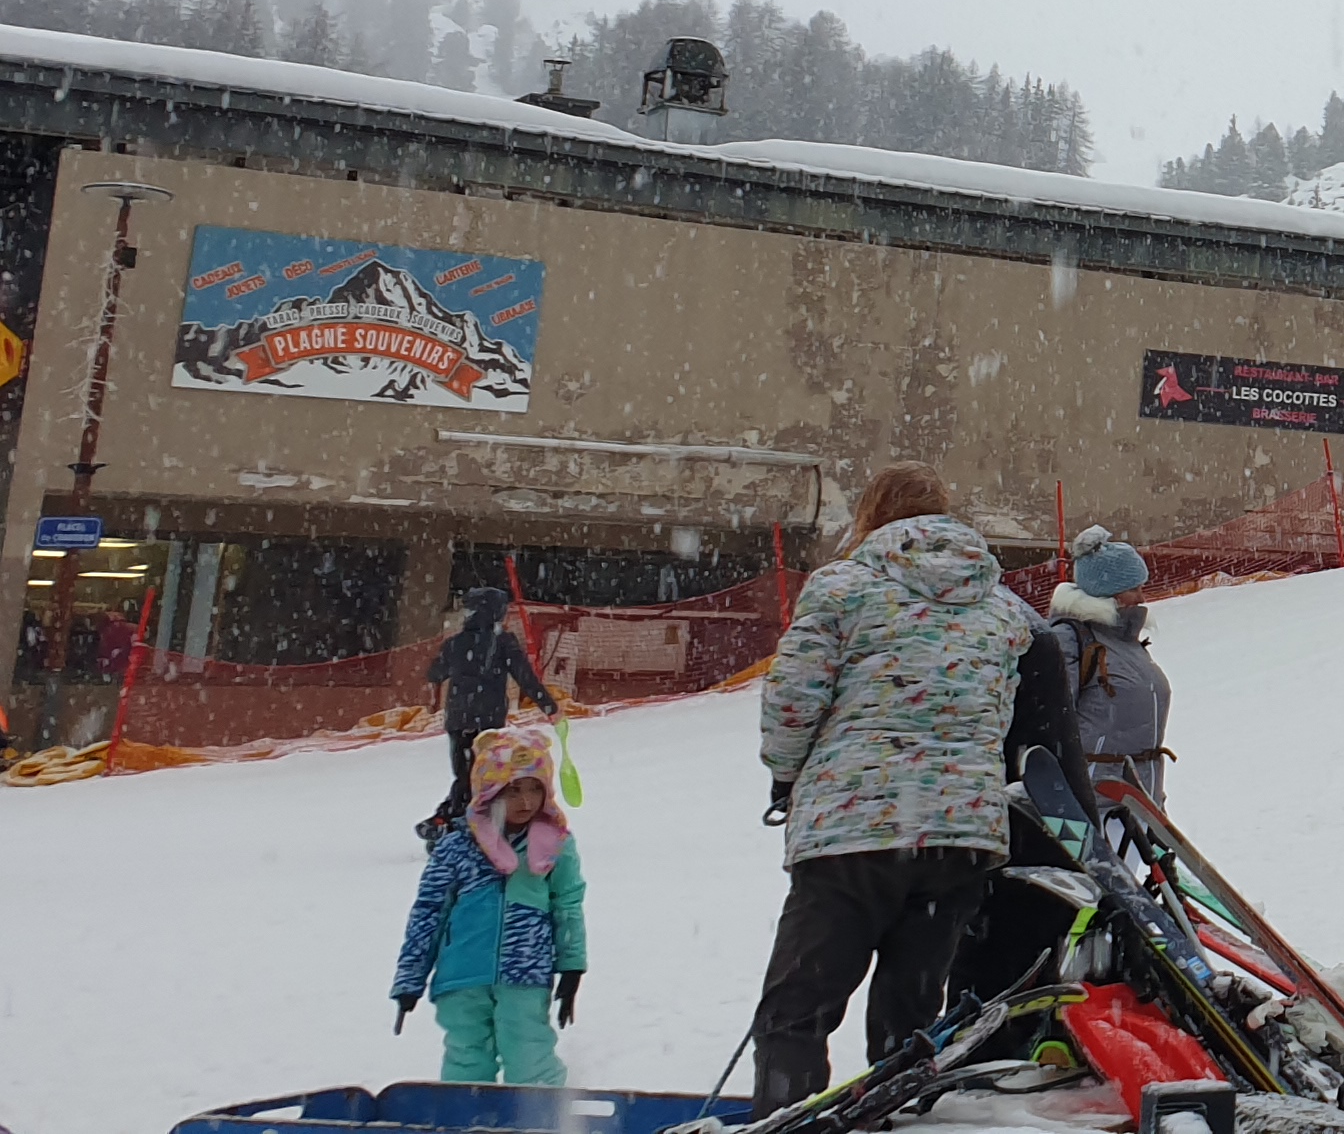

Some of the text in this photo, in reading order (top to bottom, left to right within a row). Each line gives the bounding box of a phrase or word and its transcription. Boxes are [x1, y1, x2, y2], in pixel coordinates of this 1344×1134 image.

[192, 261, 244, 290] CADEAUX
[283, 260, 314, 280] DÉCO
[435, 259, 481, 285] CARTERIE
[226, 275, 267, 298] JOUETS
[266, 304, 462, 342] TABAC PRESSE CADEAUX SOUVENIRS
[273, 327, 455, 370] PLAGNE SOUVENIRS
[1314, 373, 1340, 385] BAR
[1232, 385, 1338, 408] LES COCOTTES
[1252, 407, 1318, 424] BRASSERIE
